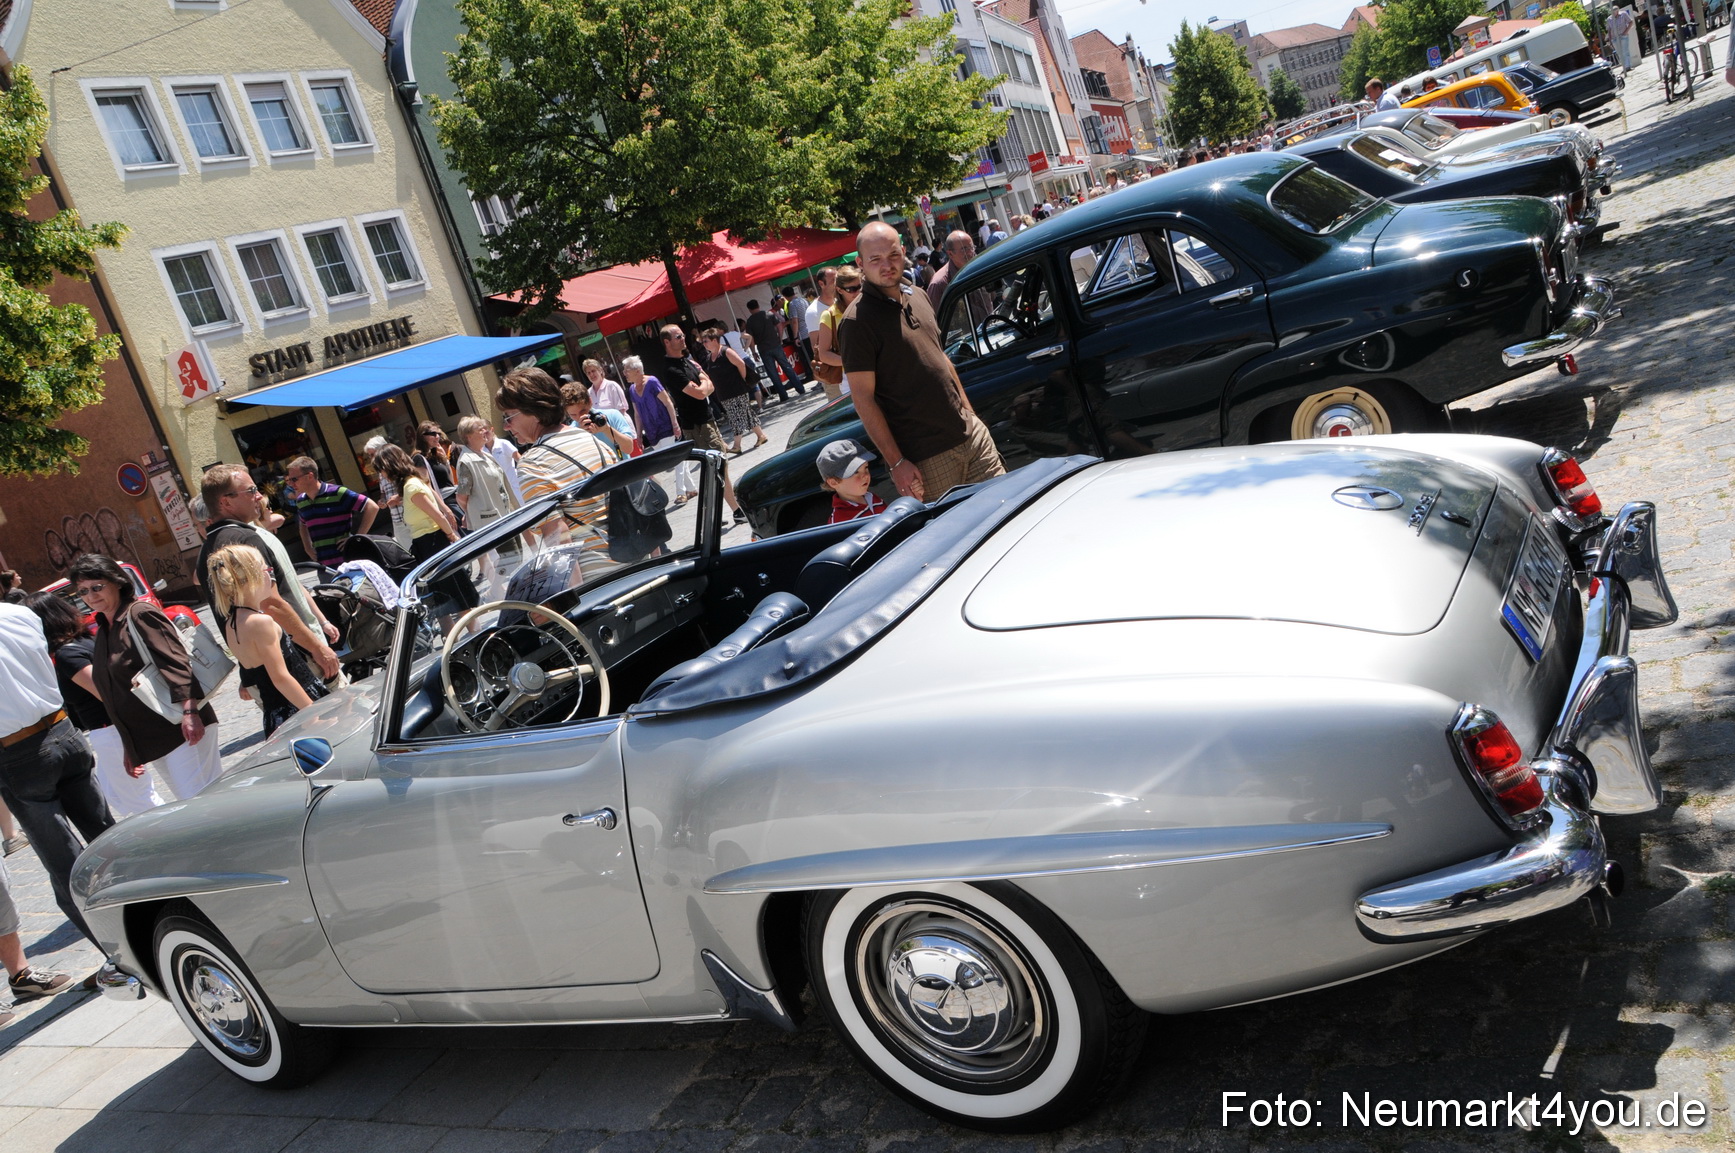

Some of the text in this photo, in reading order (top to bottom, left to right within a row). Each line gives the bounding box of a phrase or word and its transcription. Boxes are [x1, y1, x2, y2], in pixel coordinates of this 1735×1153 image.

[1460, 269, 1471, 288] S
[249, 315, 419, 378] STADT APOTHEKE
[164, 494, 181, 515] VENEZIA
[1512, 582, 1545, 638] NM
